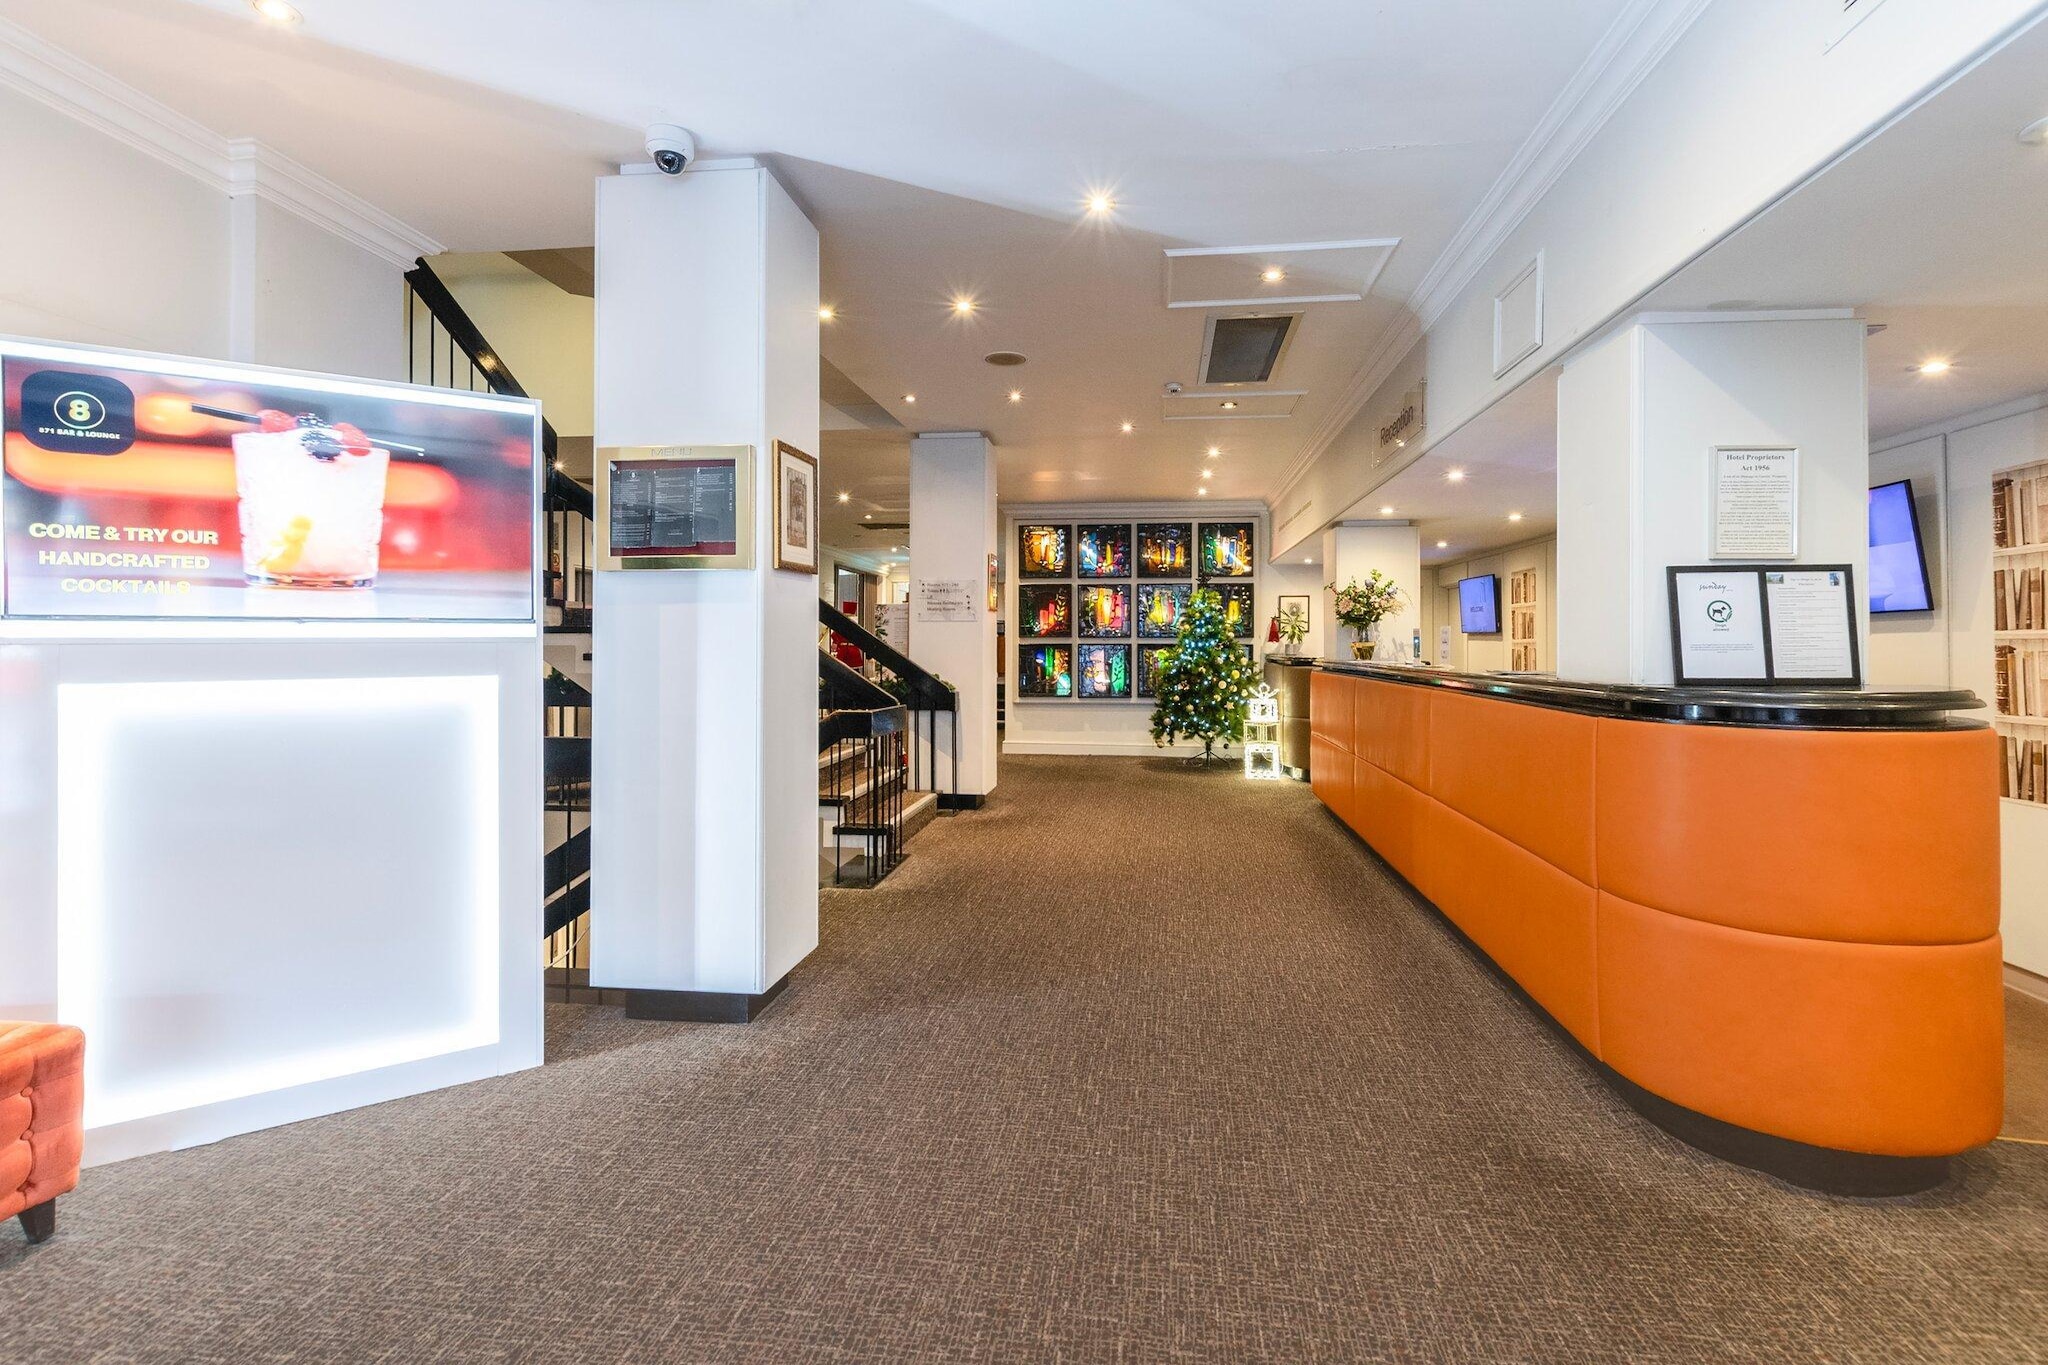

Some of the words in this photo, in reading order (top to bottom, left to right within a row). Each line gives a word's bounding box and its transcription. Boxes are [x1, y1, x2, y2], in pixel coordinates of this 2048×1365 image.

[69, 399, 91, 422] 8
[56, 428, 76, 436] BAR
[76, 429, 85, 437] &
[85, 430, 121, 440] LOUNGE
[1380, 405, 1414, 448] Reception
[650, 447, 693, 457] MENU
[1746, 454, 1785, 462] Proprietors
[28, 522, 100, 541] COME
[103, 527, 121, 541] &
[123, 527, 168, 543] TRY
[171, 529, 219, 545] OUR
[38, 550, 210, 570] HANDCRAFTED
[60, 578, 191, 595] COCKTAILS
